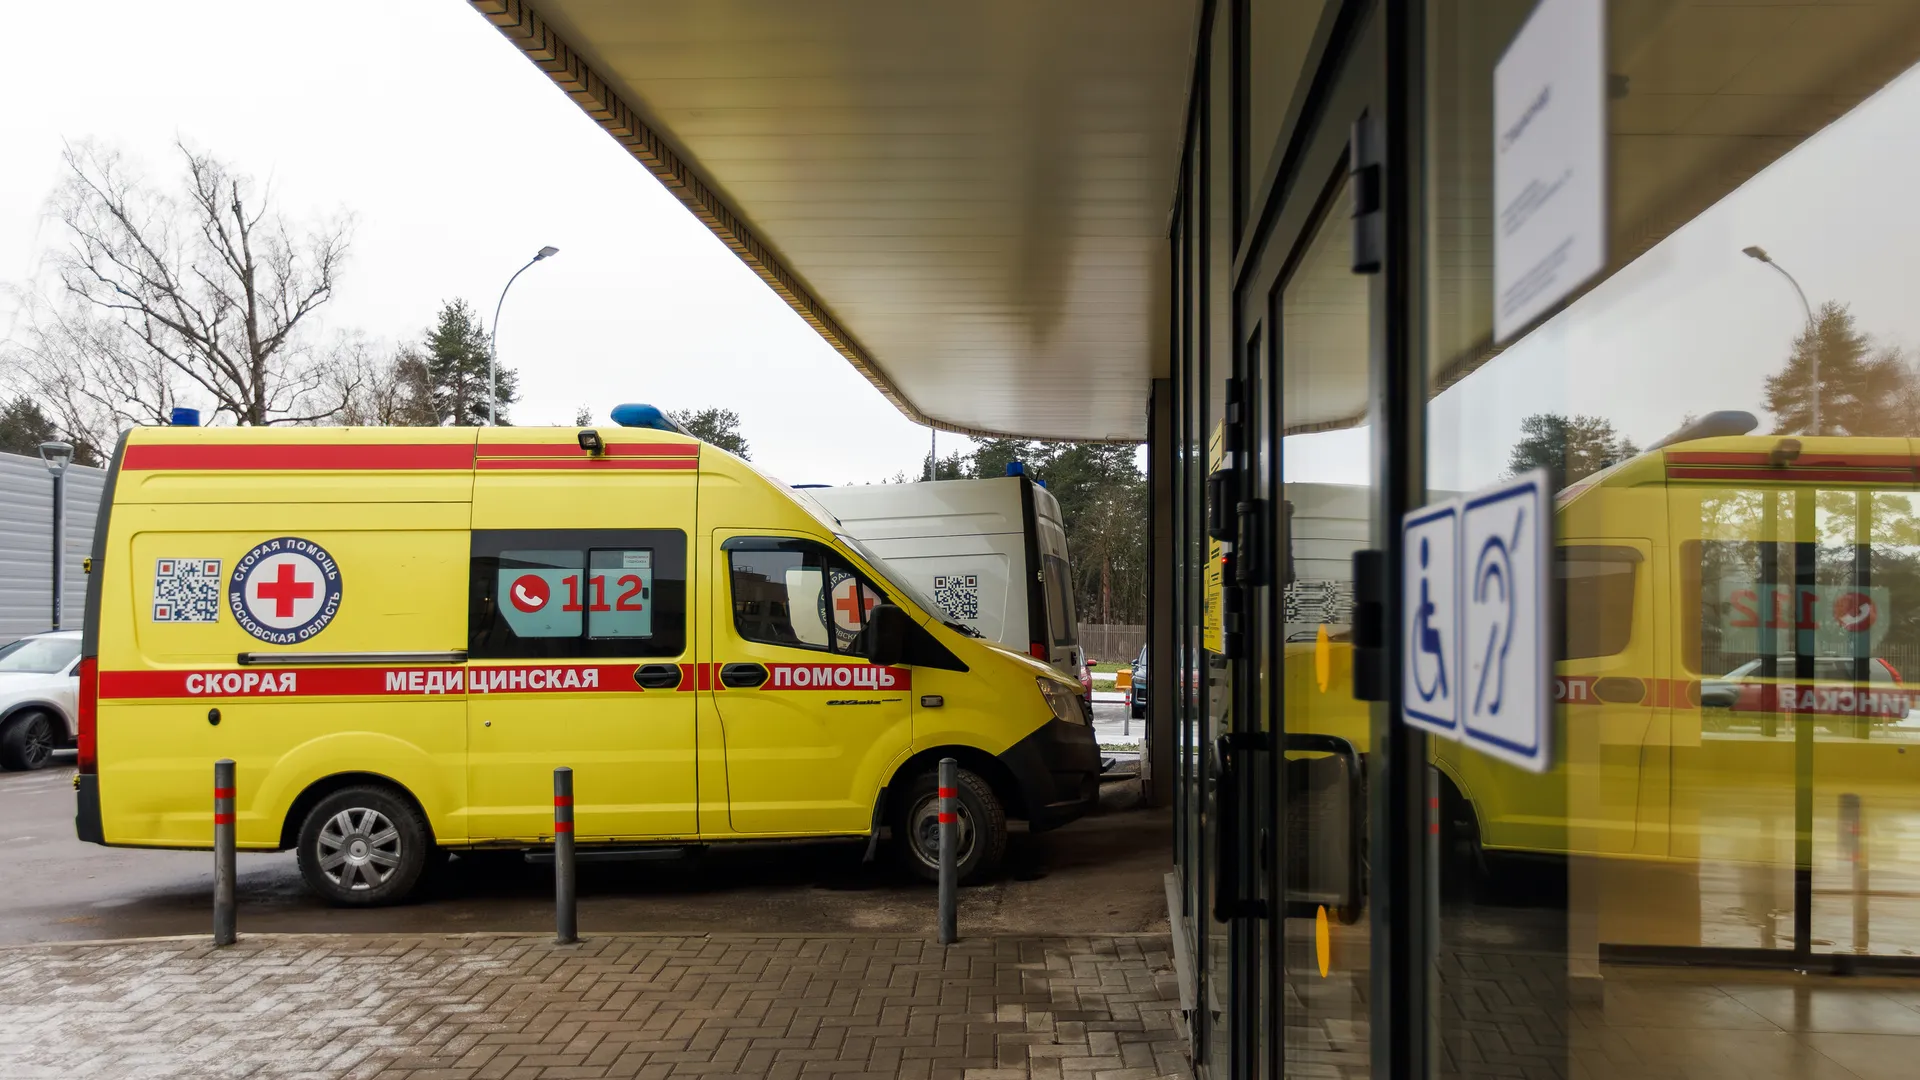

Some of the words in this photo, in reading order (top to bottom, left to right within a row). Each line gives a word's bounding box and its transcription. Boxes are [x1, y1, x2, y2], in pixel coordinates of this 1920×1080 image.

[234, 540, 281, 582] СКОРАЯ
[286, 539, 339, 581] ПОМОЩЬ
[562, 574, 643, 612] 112
[230, 592, 296, 643] МОСКОВСКАЯ
[299, 591, 341, 640] ОБЛАСТЬ
[186, 672, 297, 694] СКОРАЯ
[385, 668, 599, 694] МЕДИЦИНСКАЯ
[774, 667, 895, 690] ПОМОЩЬ
